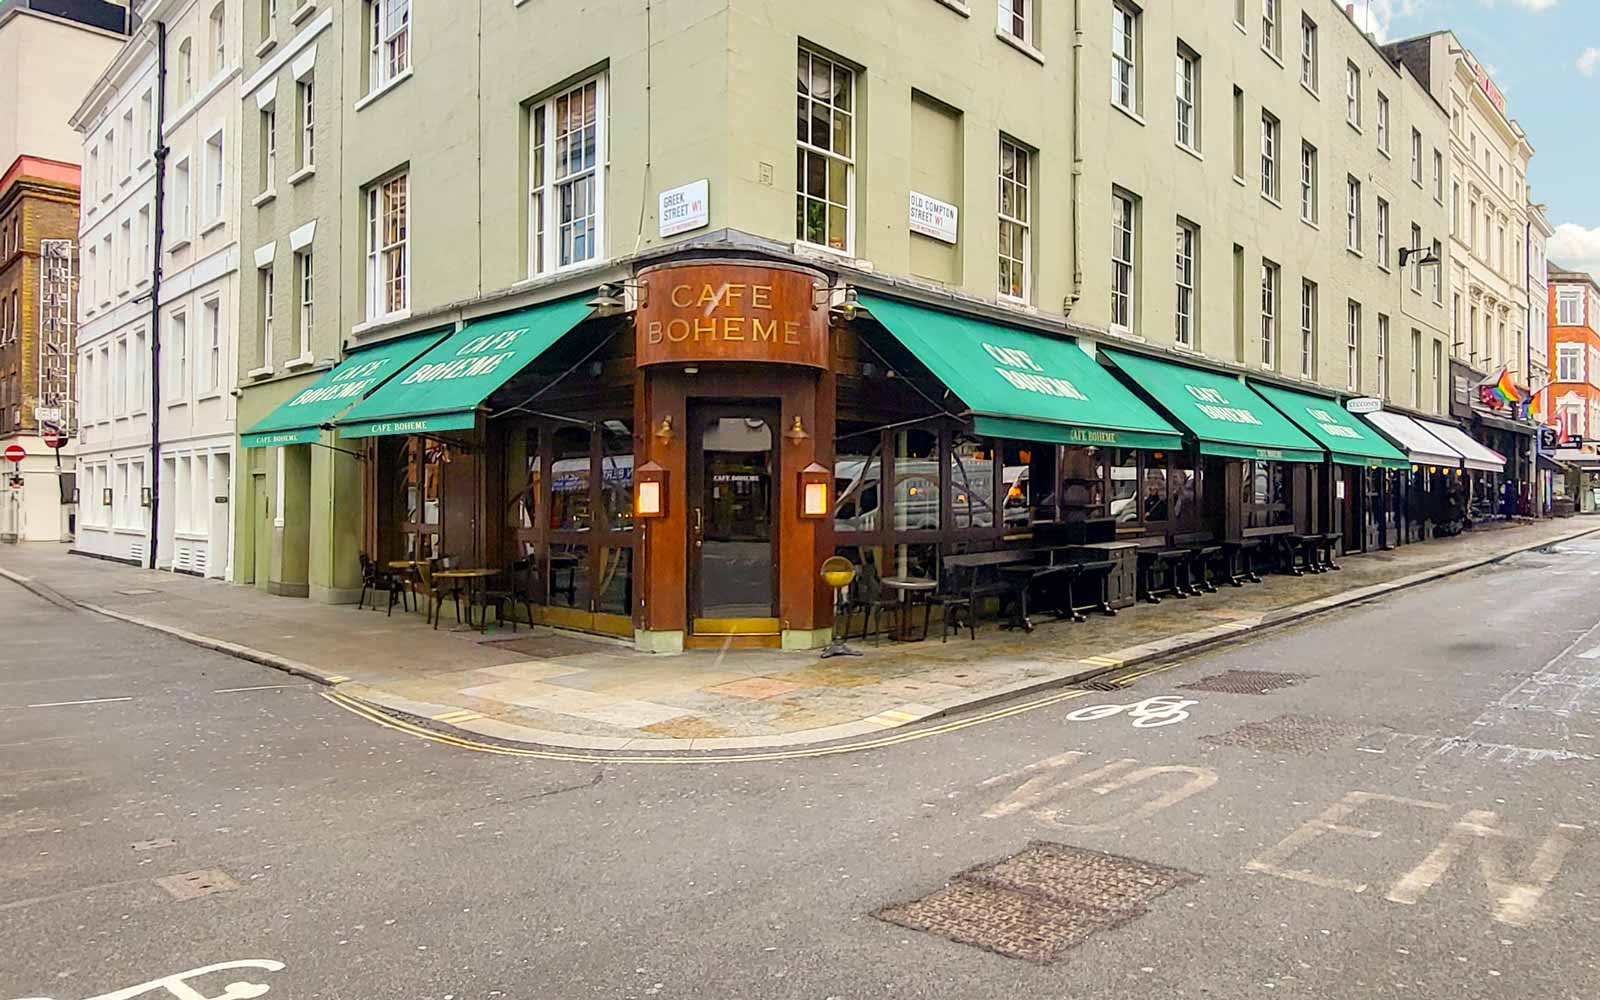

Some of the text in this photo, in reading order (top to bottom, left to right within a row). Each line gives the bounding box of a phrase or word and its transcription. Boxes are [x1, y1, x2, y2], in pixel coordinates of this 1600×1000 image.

[664, 192, 685, 208] GREEK
[664, 200, 702, 221] STREET W1
[911, 195, 954, 219] OLD COMPTON
[911, 207, 944, 227] STREET W1
[671, 283, 773, 310] CAFE
[456, 328, 530, 356] CAFE
[649, 317, 801, 345] BOHEME
[400, 351, 516, 385] BOHEME
[981, 341, 1045, 371] CAFE
[331, 358, 391, 382] CAFE
[288, 377, 377, 407] BOHEME
[994, 366, 1090, 401] BOHEME
[1184, 384, 1230, 405] CAFE
[1195, 402, 1264, 426] BOHEME
[256, 434, 298, 444] CAFE BOHEME
[371, 421, 427, 433] CAFE BOHEME
[1070, 429, 1116, 443] CAFE BOHEME
